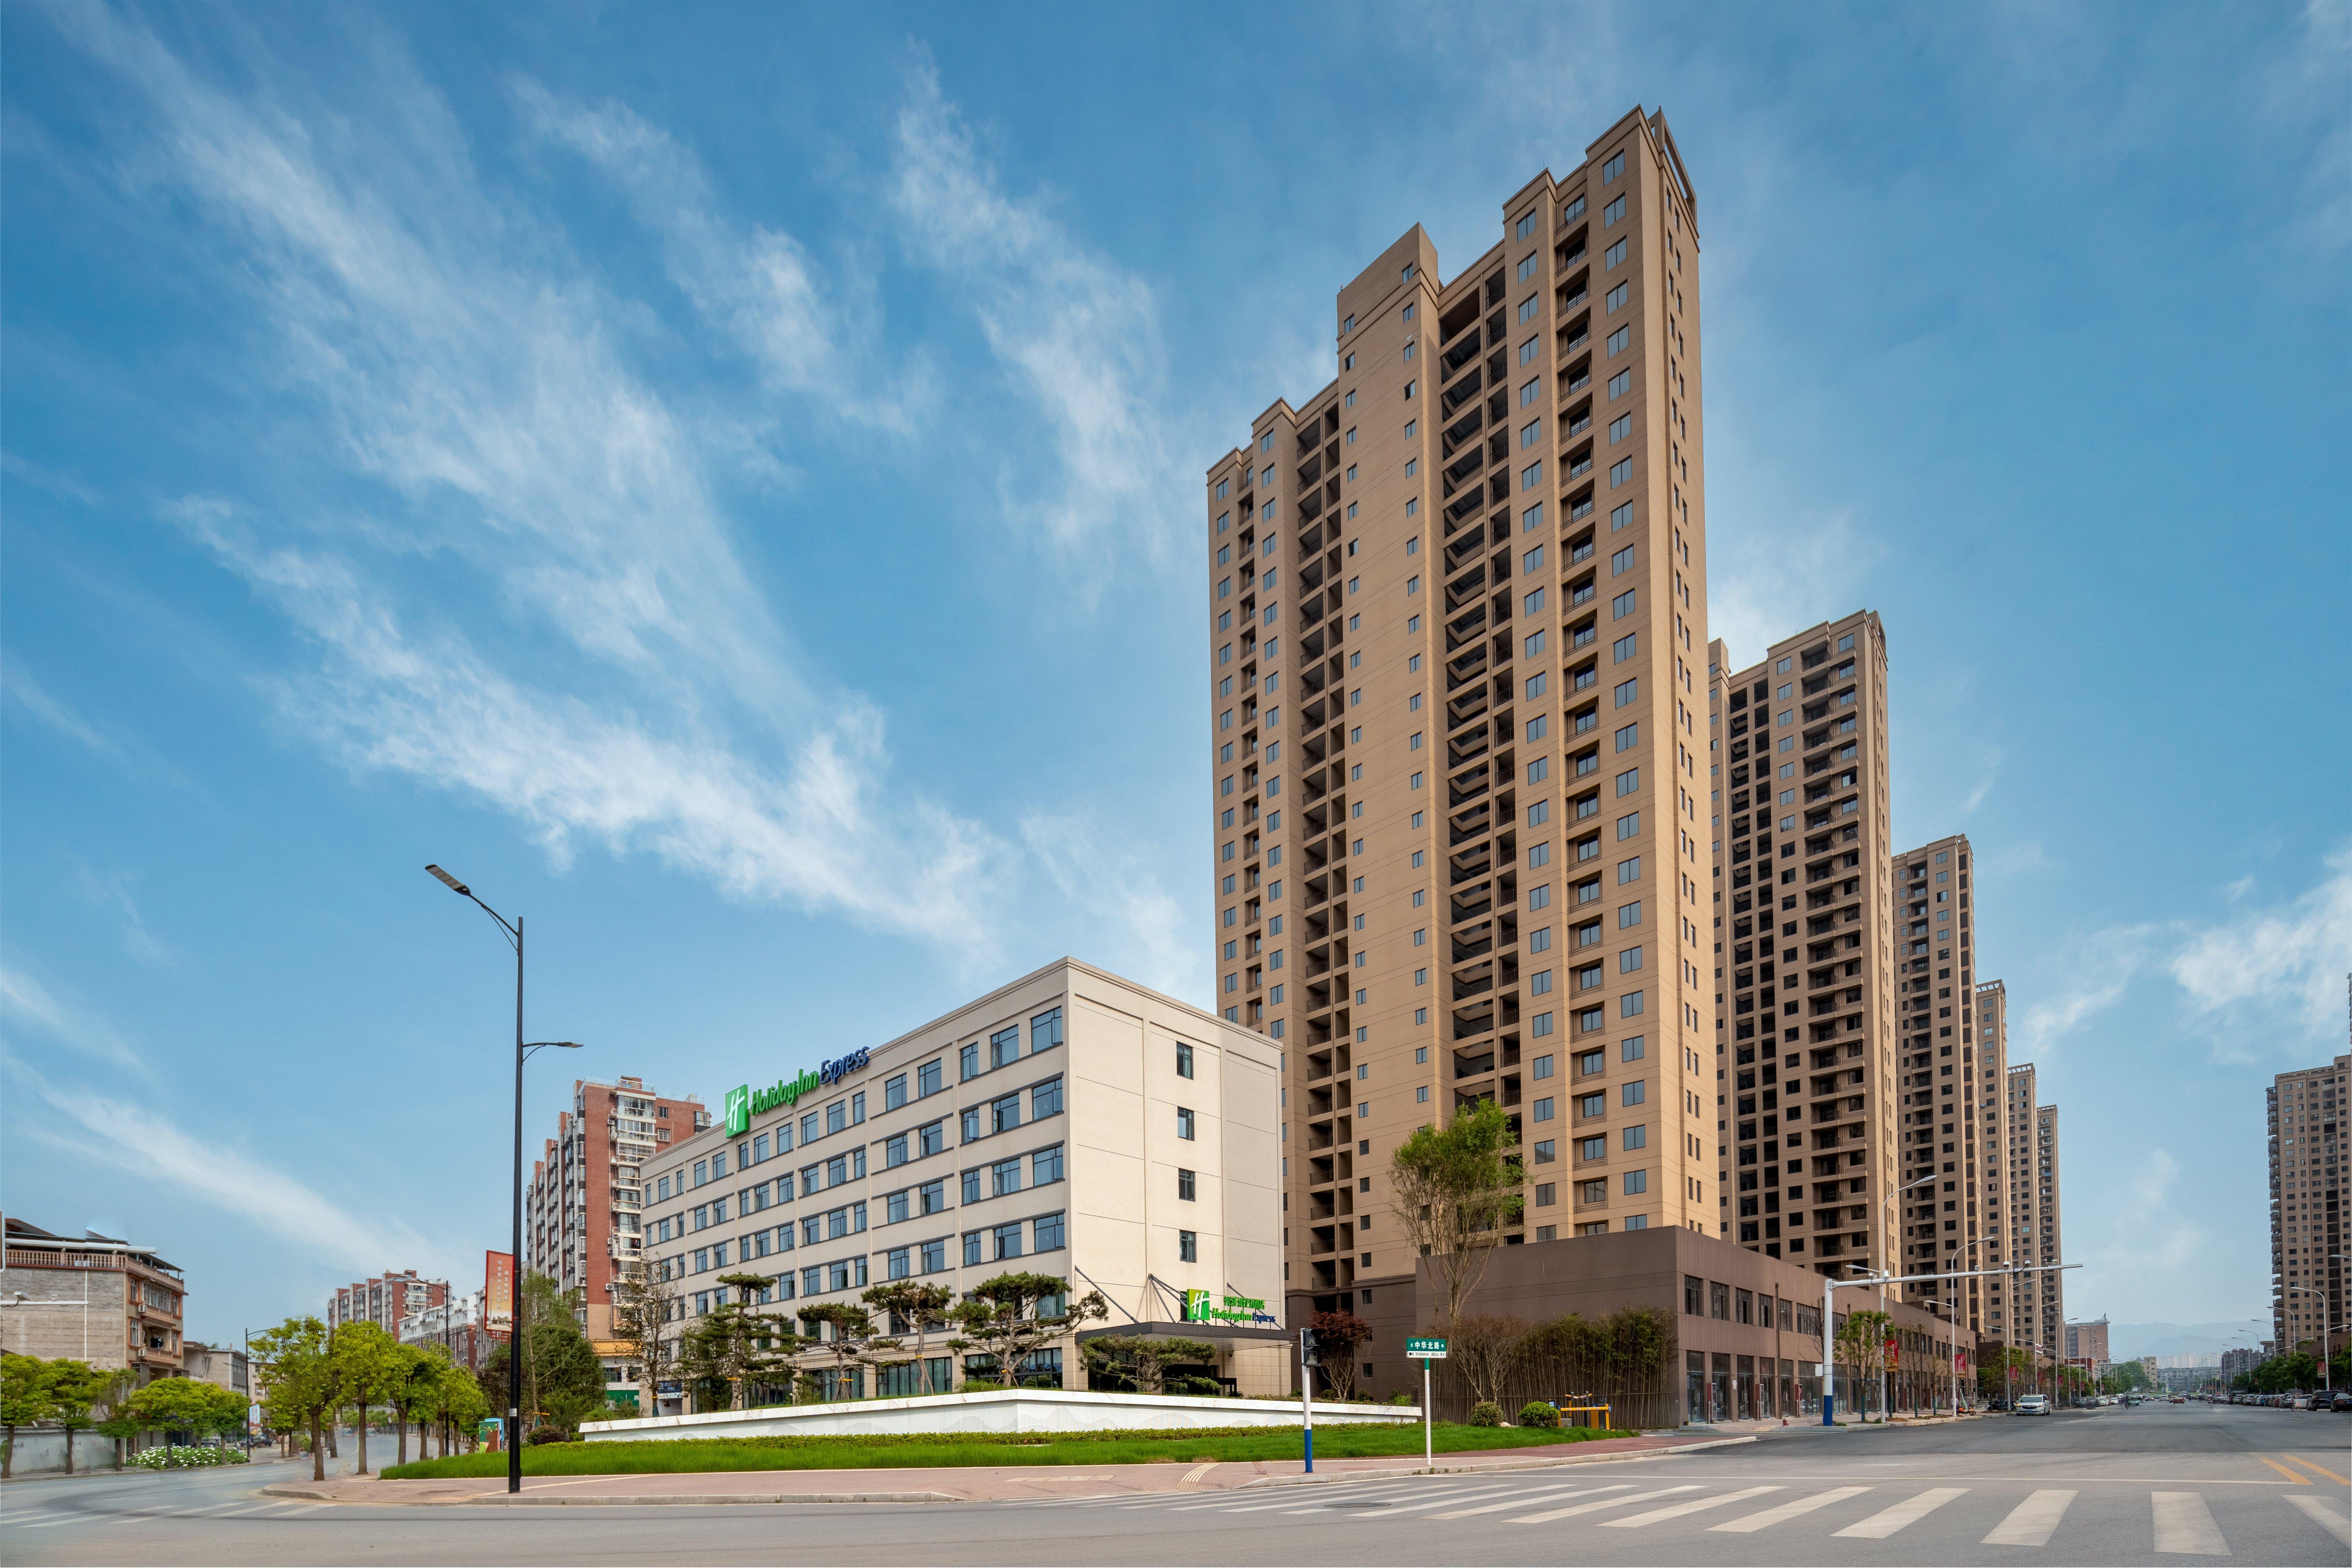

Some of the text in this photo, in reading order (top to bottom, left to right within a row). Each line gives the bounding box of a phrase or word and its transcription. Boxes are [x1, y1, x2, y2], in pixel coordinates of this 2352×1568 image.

[820, 1046, 869, 1085] Express
[1223, 1295, 1265, 1310] 智选假日酒店
[1252, 1312, 1276, 1324] Express
[1415, 1341, 1439, 1350] 中华北路
